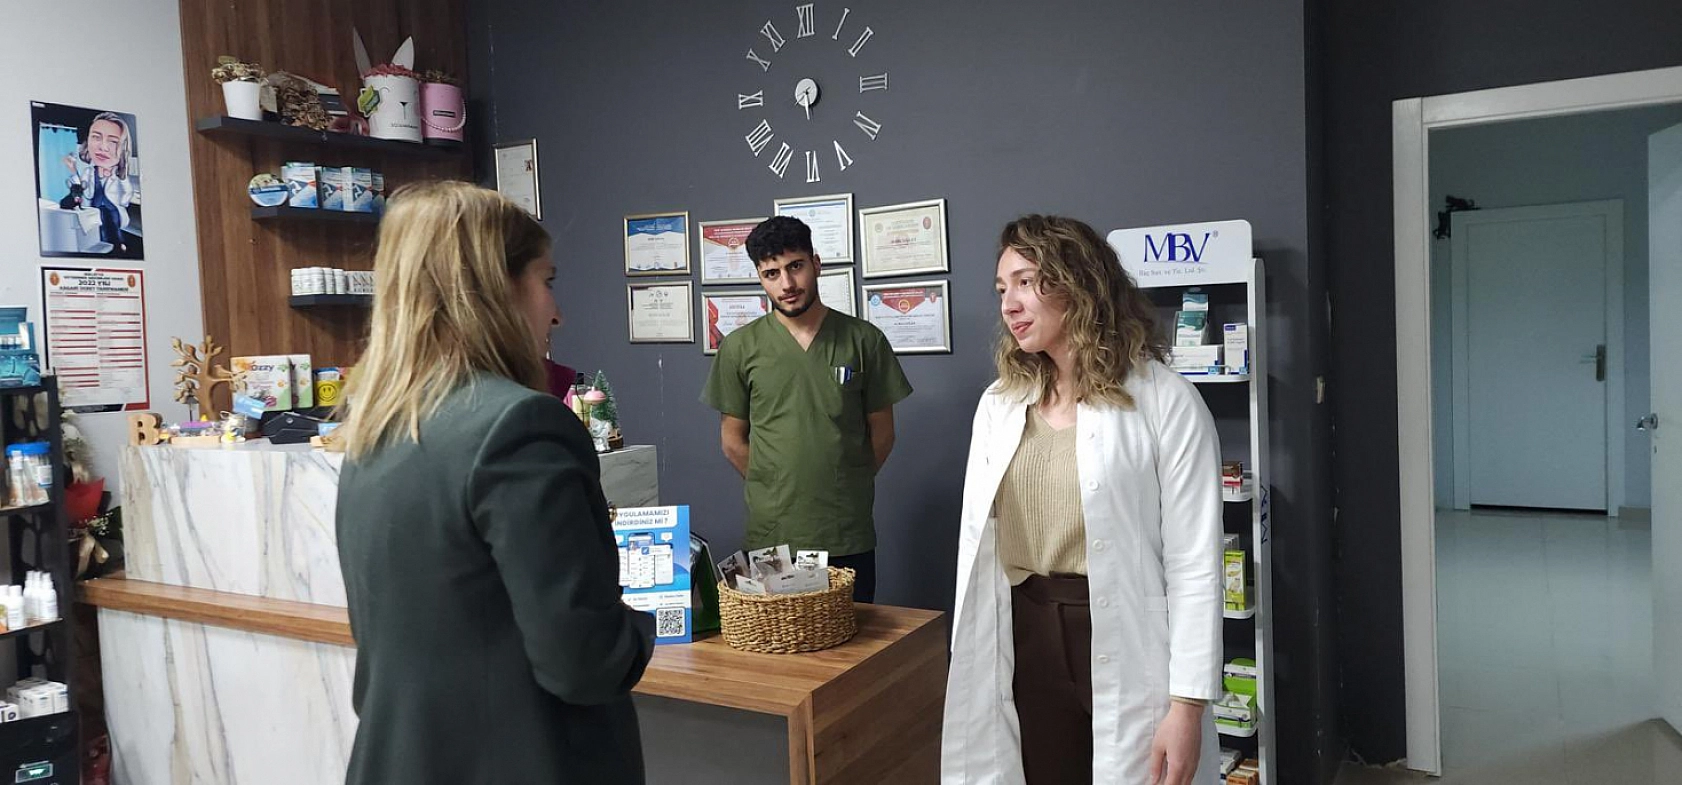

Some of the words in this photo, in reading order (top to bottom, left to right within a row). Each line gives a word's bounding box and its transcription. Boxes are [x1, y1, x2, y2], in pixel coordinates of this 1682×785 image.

[796, 3, 815, 38] XII
[760, 20, 786, 53] XI
[848, 26, 874, 57] II
[746, 48, 771, 72] X
[859, 72, 888, 94] III
[738, 89, 763, 110] IX
[745, 118, 775, 157] VIII
[853, 110, 882, 140] IV
[768, 141, 794, 178] VII
[805, 150, 821, 183] VI
[833, 140, 854, 171] V
[1144, 232, 1211, 262] MBV
[616, 509, 670, 518] YGULAMAMIZI
